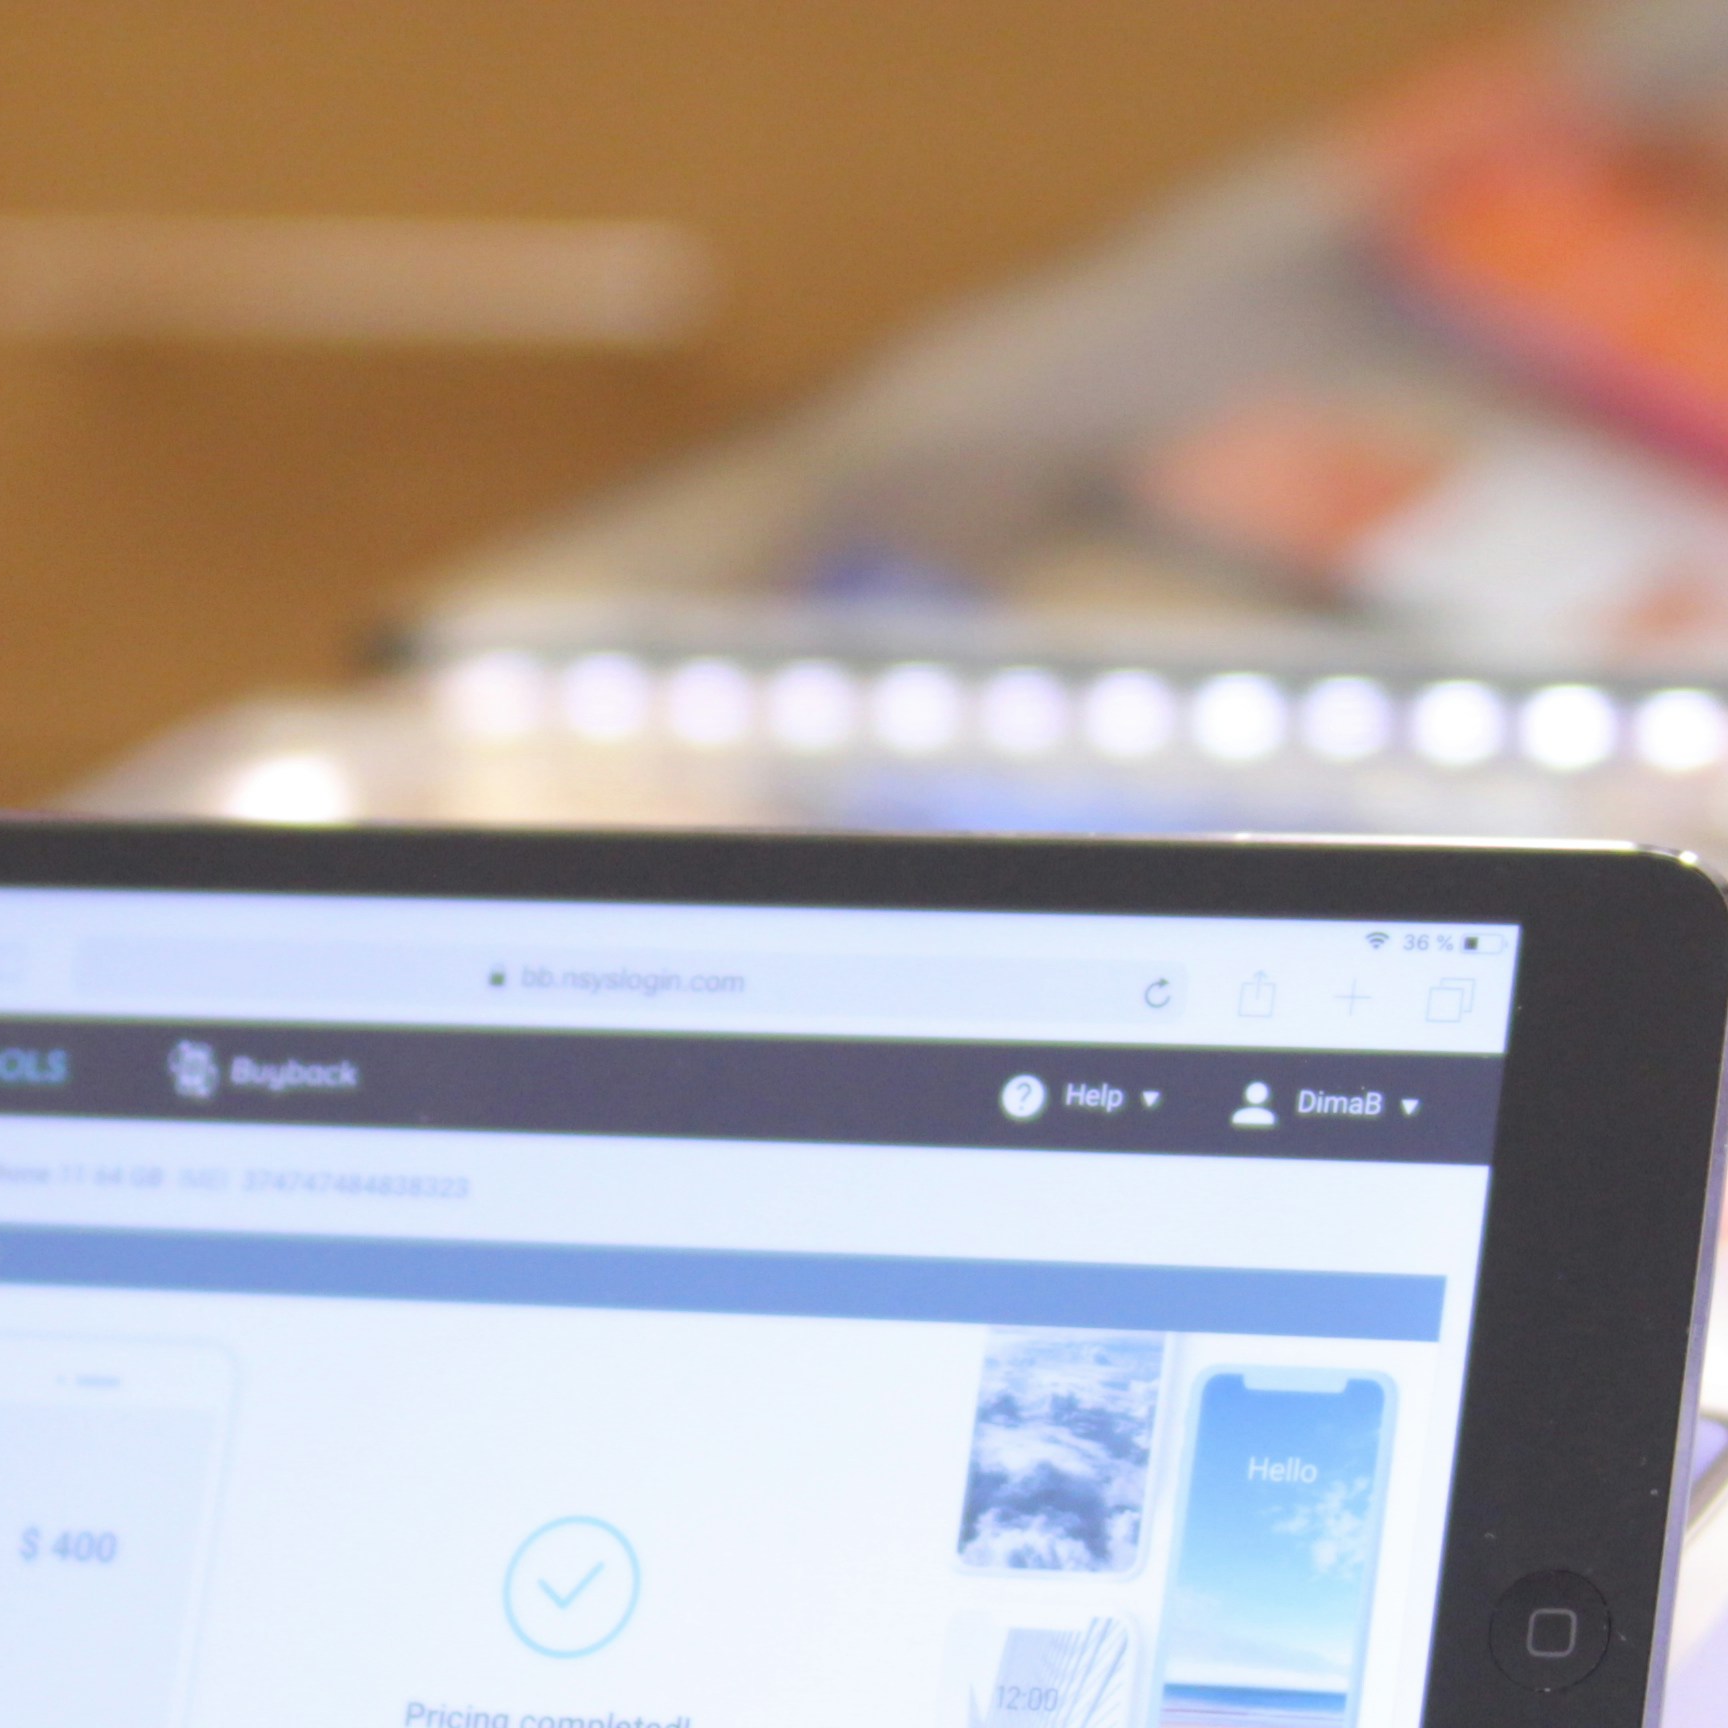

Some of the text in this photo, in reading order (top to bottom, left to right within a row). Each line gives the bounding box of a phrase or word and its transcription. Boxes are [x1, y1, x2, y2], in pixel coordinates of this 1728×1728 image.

[1402, 934, 1432, 953] 36
[520, 963, 746, 997] bb.nsyslogin.com
[230, 1054, 359, 1095] Buyback
[1064, 1081, 1125, 1113] Help
[1296, 1089, 1384, 1119] DimaB
[1246, 1455, 1318, 1484] Hello
[51, 1529, 120, 1565] 400
